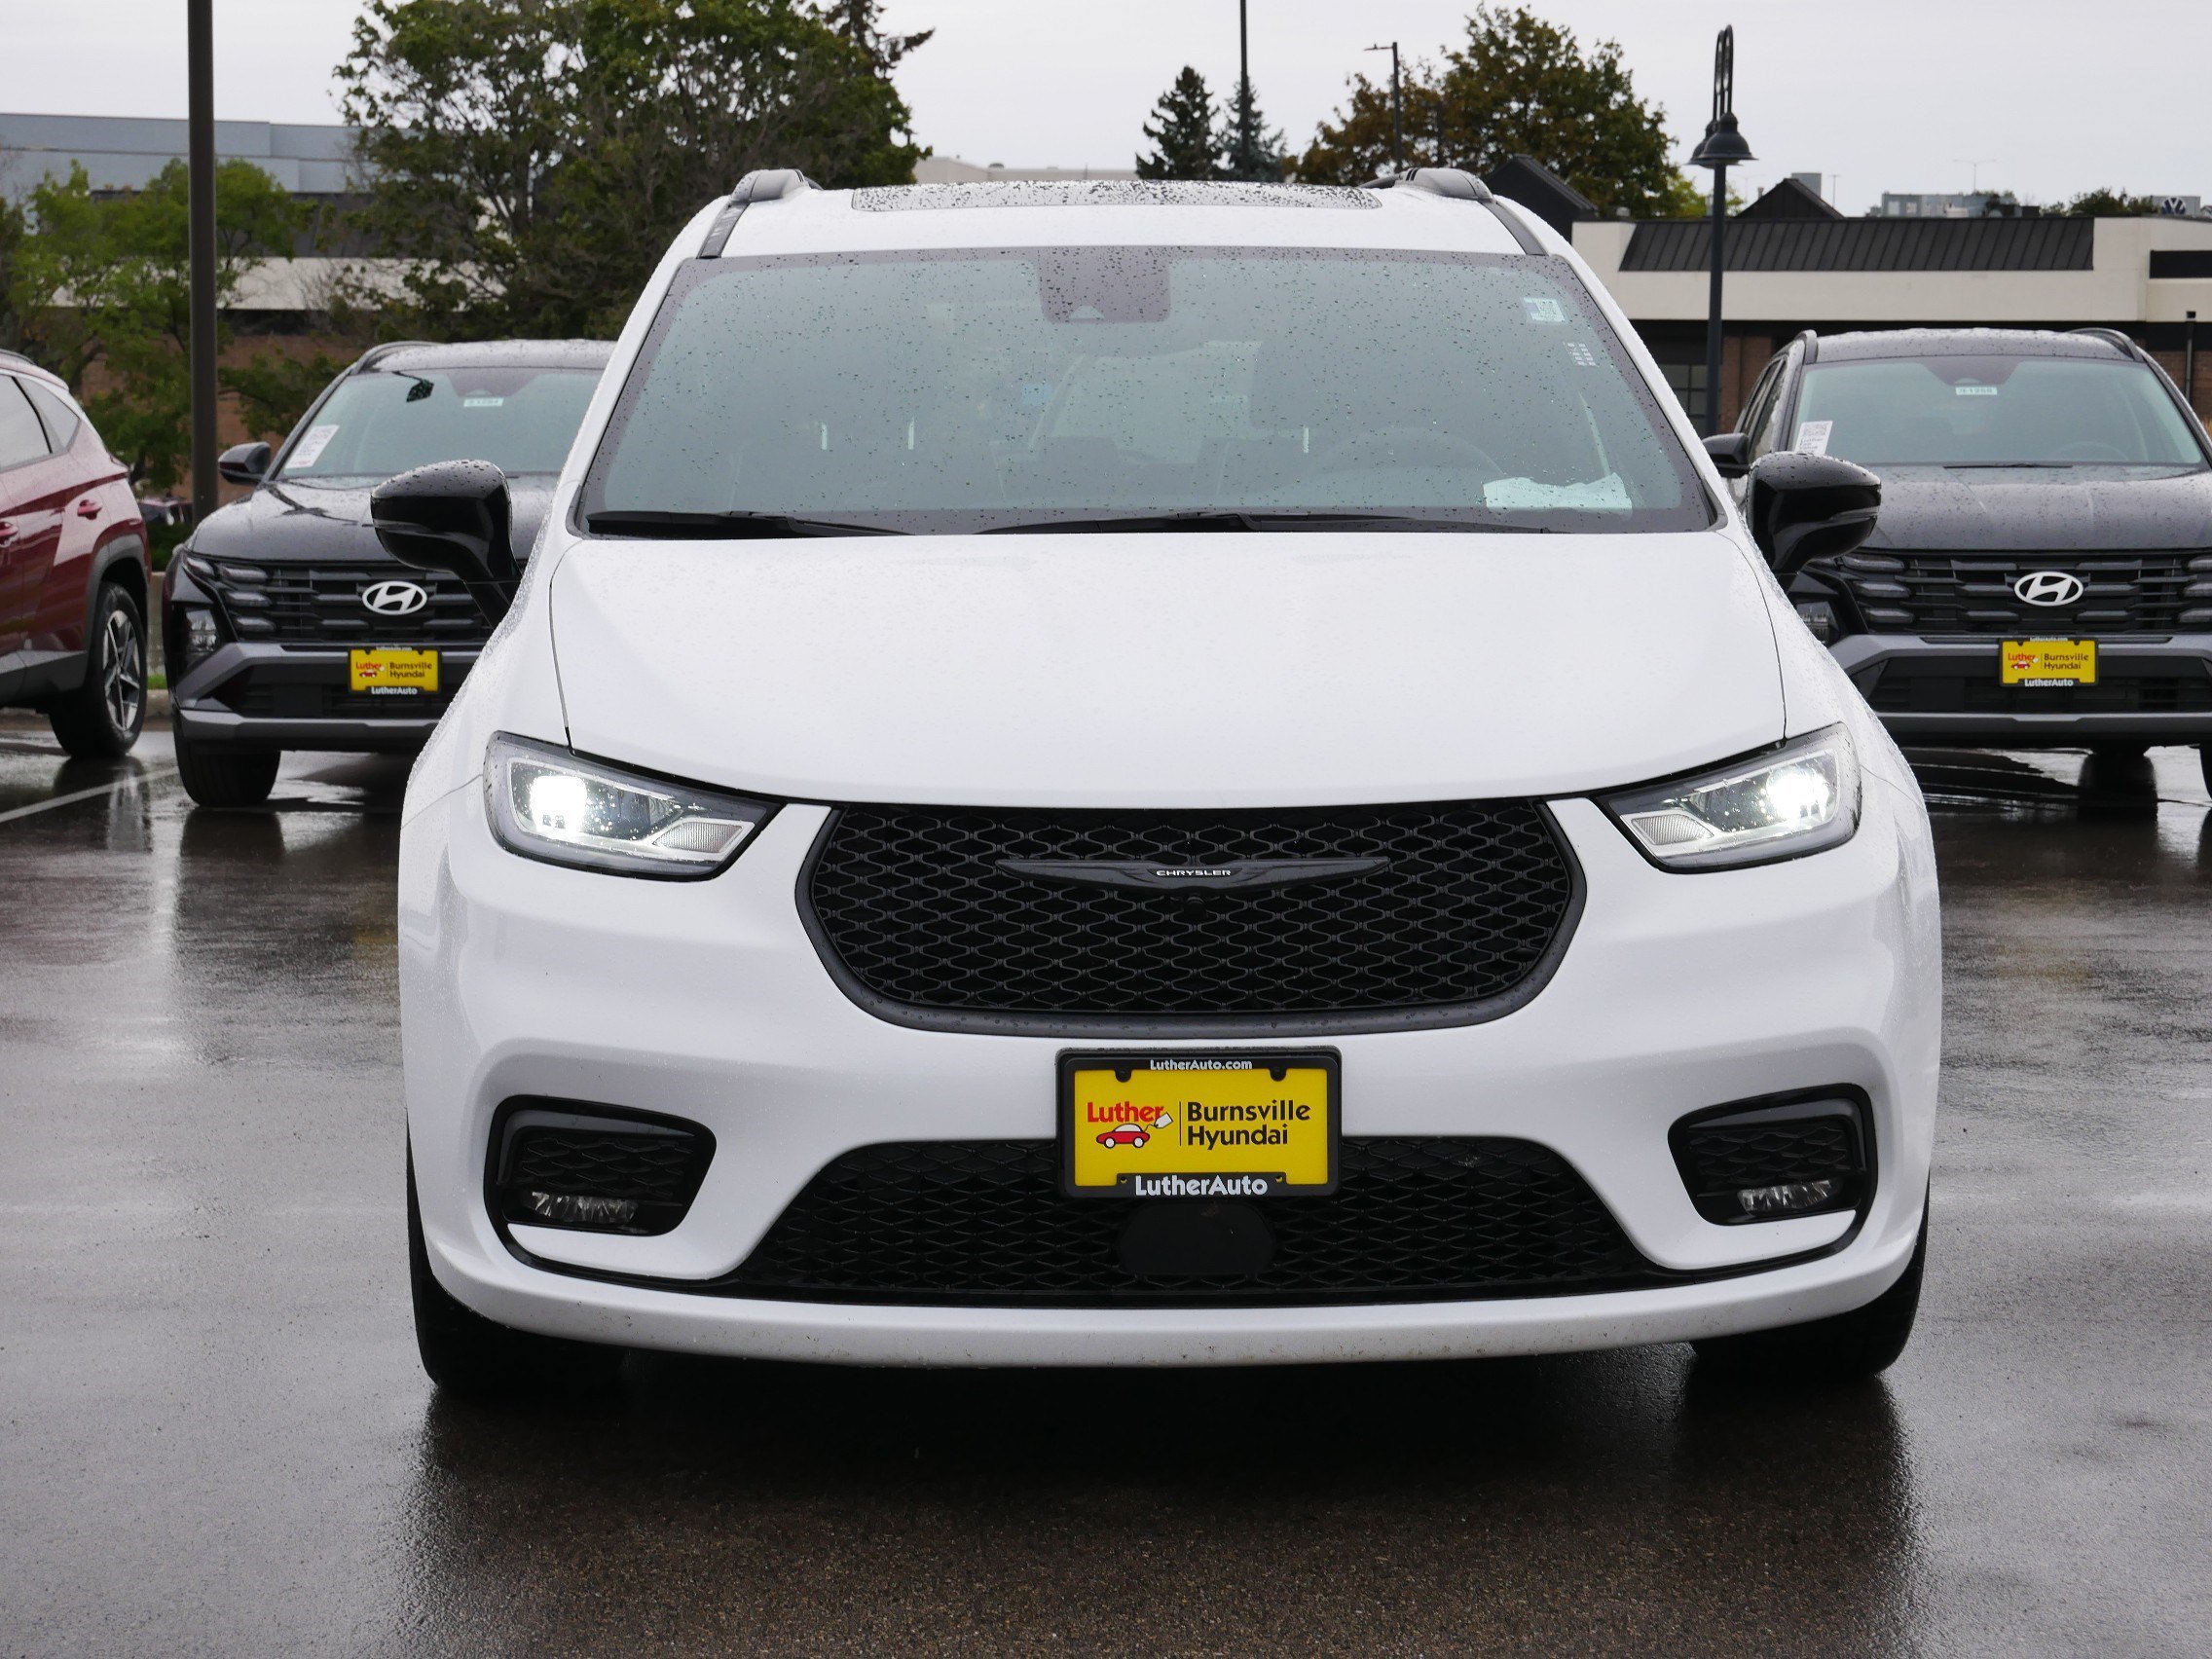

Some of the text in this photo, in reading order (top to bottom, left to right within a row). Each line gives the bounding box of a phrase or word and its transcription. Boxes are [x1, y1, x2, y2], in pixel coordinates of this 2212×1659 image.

[2044, 662, 2082, 671] Hyundai
[389, 670, 425, 679] Hyundai
[2024, 679, 2074, 687] LutherAuto
[371, 686, 418, 695] LutherAuto
[1149, 1059, 1253, 1071] LutherAuto.com
[1087, 1101, 1164, 1124] Luther
[1186, 1099, 1311, 1122] Burnsville
[1186, 1124, 1288, 1150] Hyundai
[1134, 1174, 1269, 1197] LutherAuto
